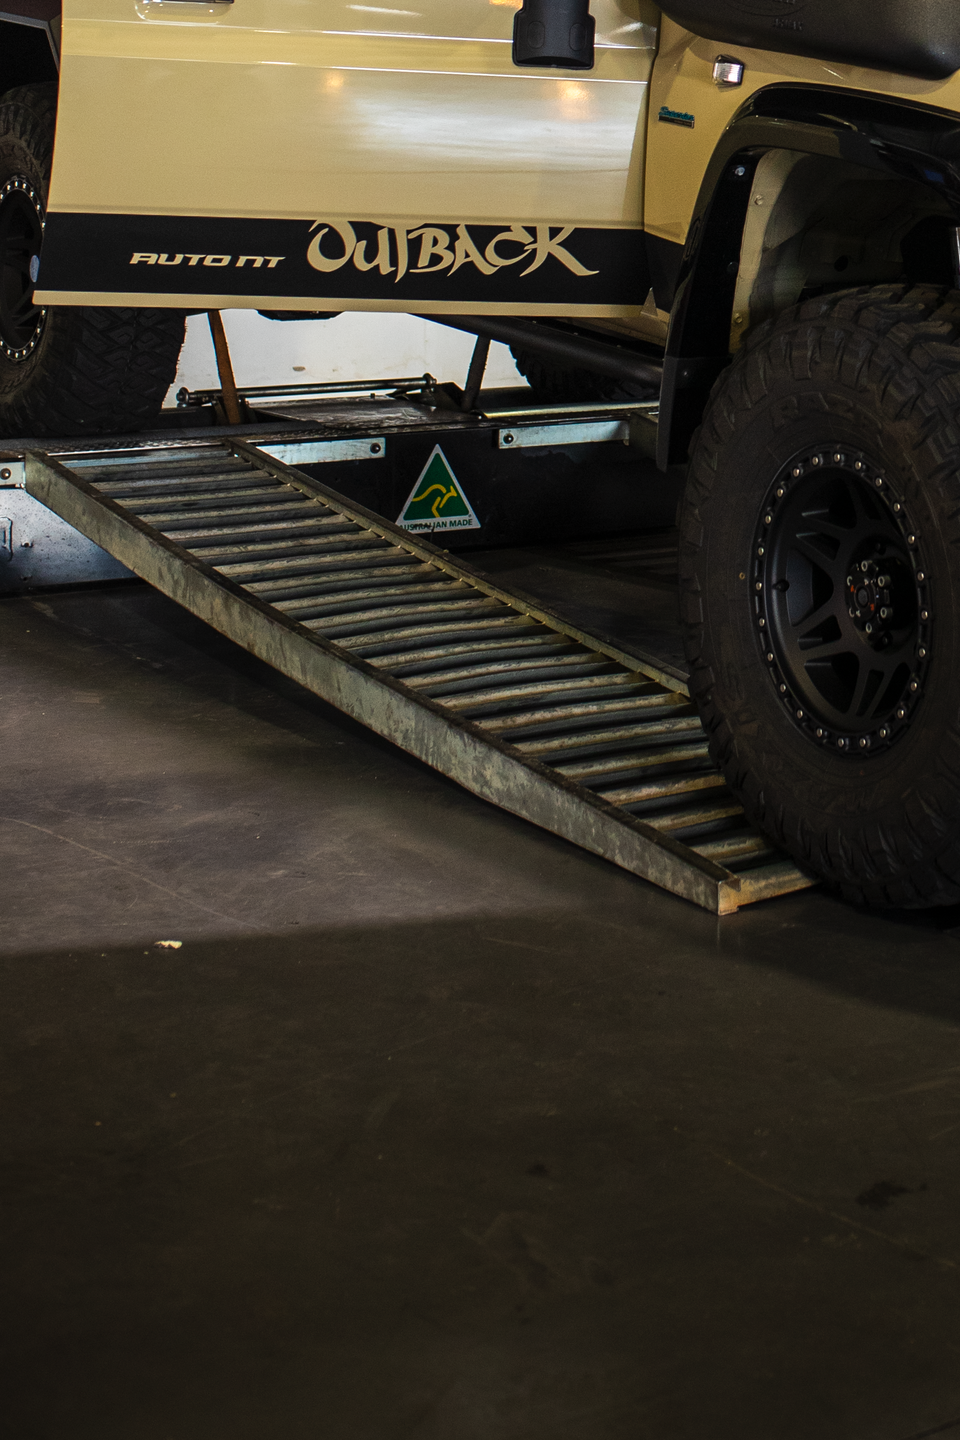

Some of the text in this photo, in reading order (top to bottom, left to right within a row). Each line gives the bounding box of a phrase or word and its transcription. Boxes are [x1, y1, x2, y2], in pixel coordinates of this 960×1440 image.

[129, 252, 286, 268] AUTO NT
[449, 519, 473, 527] MADE
